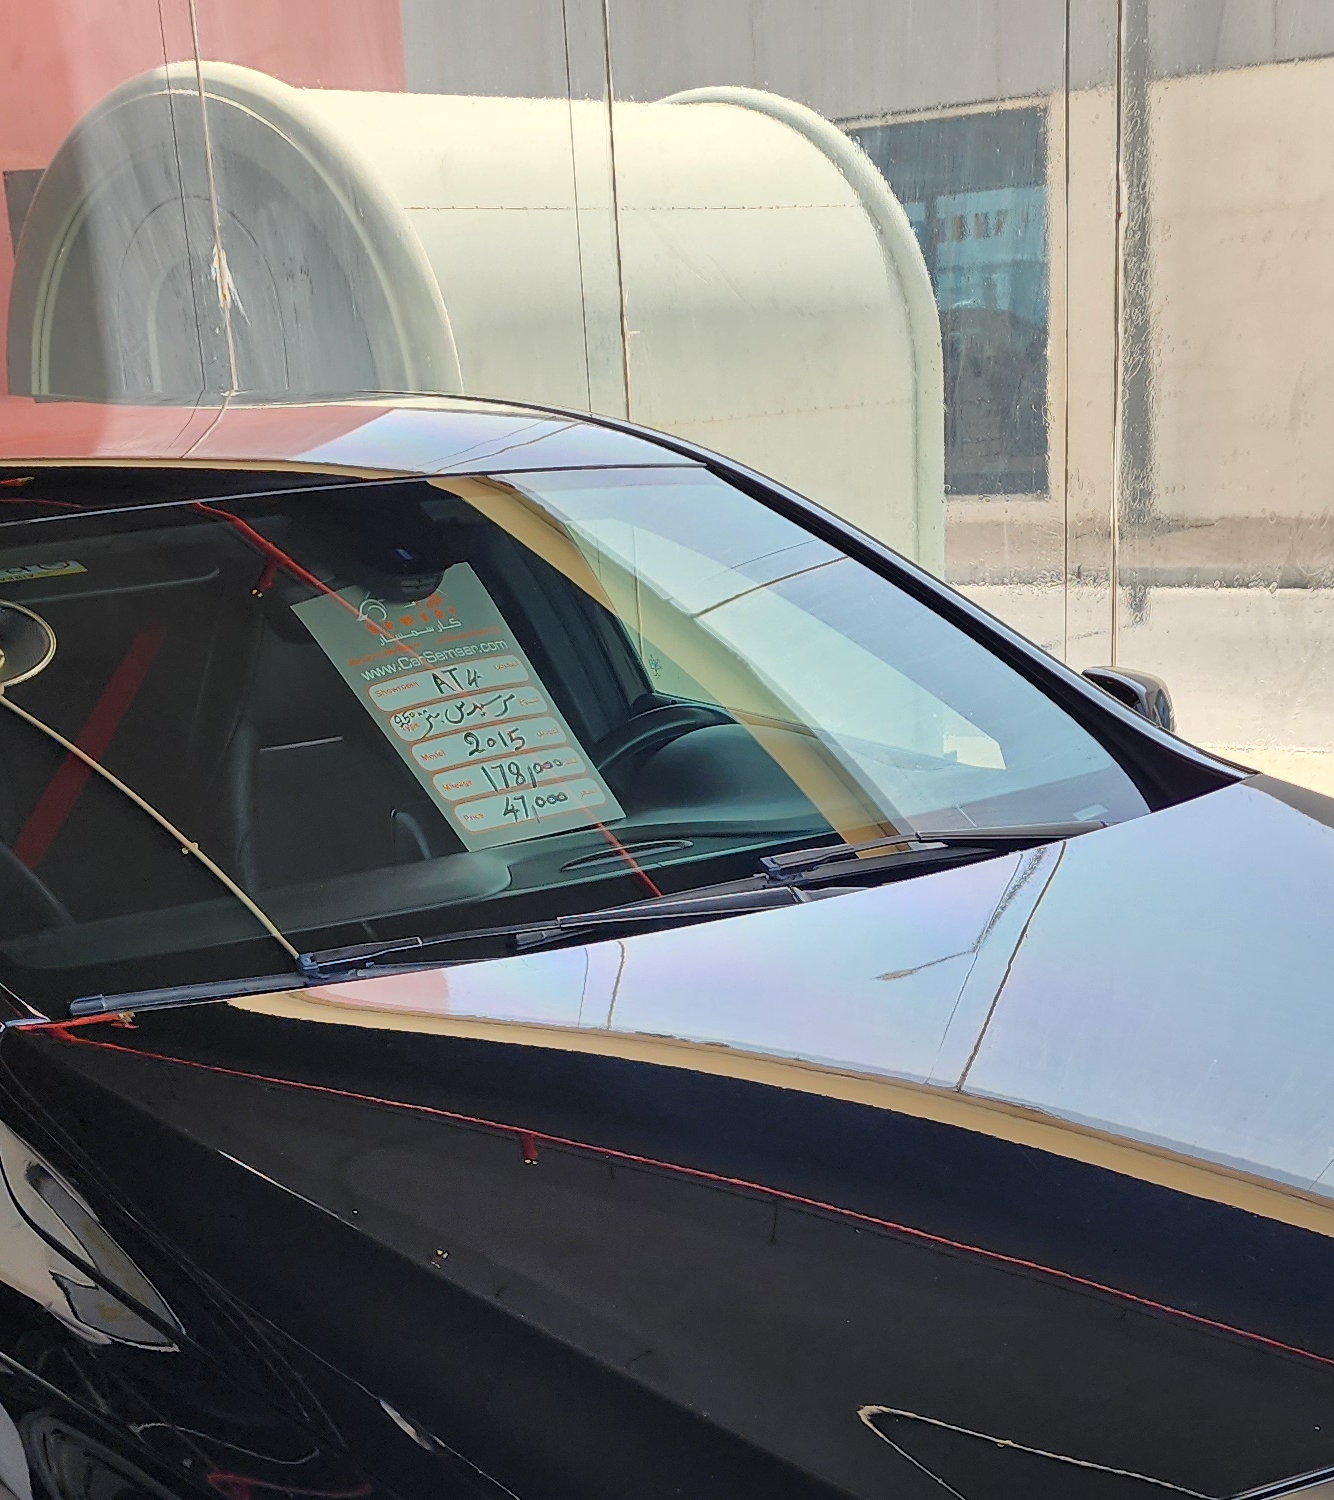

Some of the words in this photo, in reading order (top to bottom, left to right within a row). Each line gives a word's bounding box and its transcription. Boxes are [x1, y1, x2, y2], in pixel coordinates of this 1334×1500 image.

[437, 617, 462, 633] كار
[360, 638, 509, 682] www.CarSemsar.com
[420, 749, 446, 761] Model
[463, 728, 526, 756] 2015
[480, 758, 563, 793] 178,000
[463, 812, 484, 821] Price
[502, 792, 568, 824] 47,000
